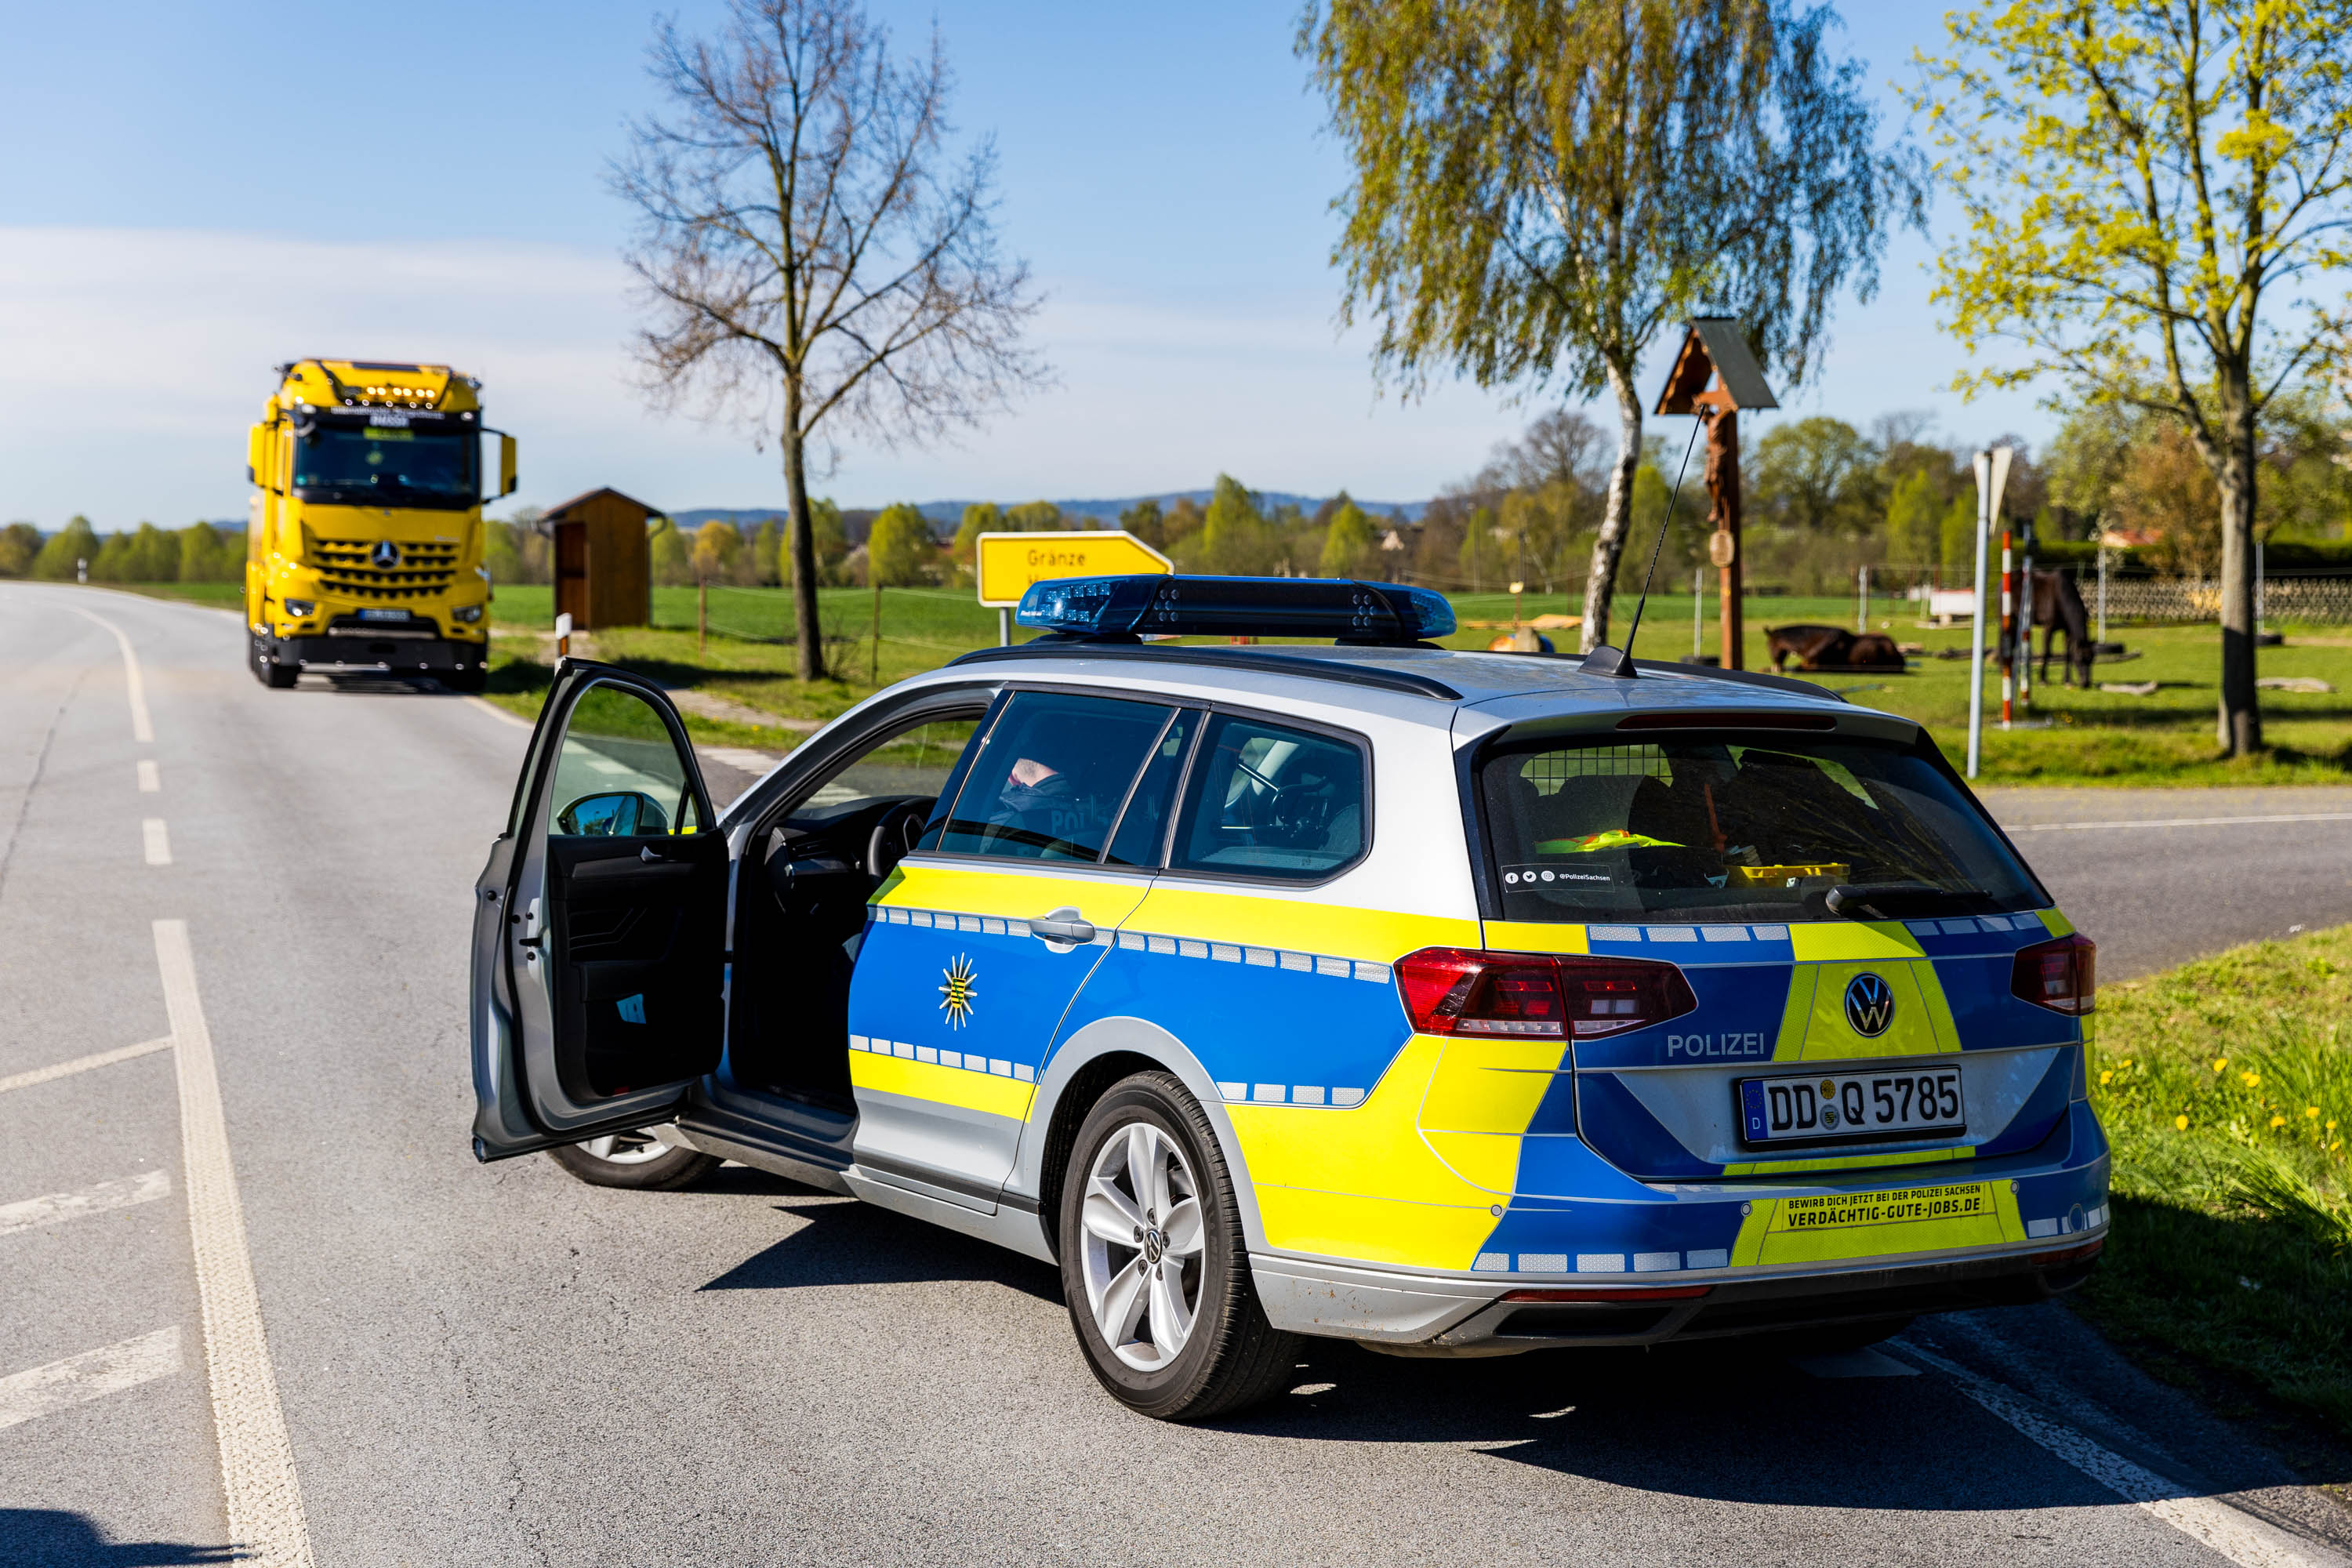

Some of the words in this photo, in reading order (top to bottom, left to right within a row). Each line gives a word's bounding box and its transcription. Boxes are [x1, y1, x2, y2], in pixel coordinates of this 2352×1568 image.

[1846, 974, 1893, 1036] VW
[1668, 1033, 1764, 1057] POLIZEI
[1768, 1085, 1817, 1131] DD
[1842, 1082, 1865, 1125] Q
[1872, 1075, 1958, 1123] 5785
[1752, 1117, 1761, 1130] D
[1789, 1198, 1824, 1209] BEWIRB
[1828, 1196, 1847, 1206] DICH
[1849, 1194, 1874, 1207] JETZT
[1876, 1192, 1889, 1202] BEI
[1893, 1191, 1908, 1200] DER
[1911, 1189, 1942, 1199] POLIZEI
[1944, 1185, 1980, 1196] SACHSEN
[1788, 1198, 1980, 1227] VERDÄCHTIG-GUTE-JOBS.DE
